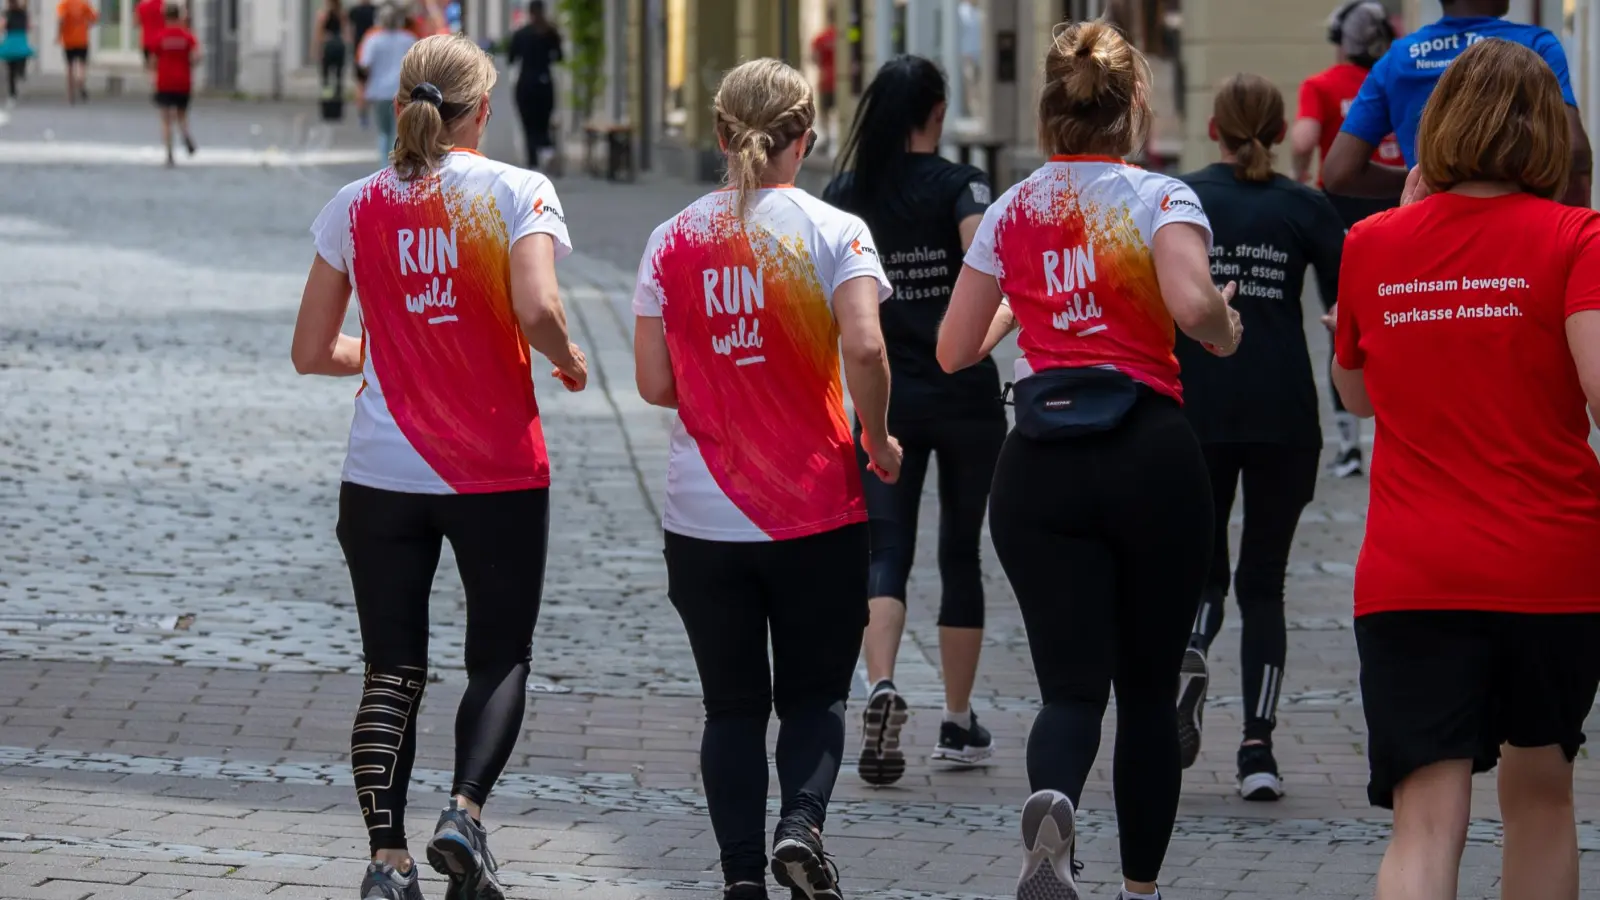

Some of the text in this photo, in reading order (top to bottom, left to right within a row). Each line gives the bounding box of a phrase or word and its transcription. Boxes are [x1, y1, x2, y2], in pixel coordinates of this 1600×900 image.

[1409, 33, 1459, 58] sport
[397, 227, 458, 276] RUN
[1235, 243, 1289, 264] strahlen
[1042, 242, 1097, 297] RUN
[1251, 265, 1286, 282] essen
[406, 277, 457, 314] wild
[702, 265, 765, 318] RUN
[1239, 279, 1284, 300] küssen
[1378, 276, 1530, 297] Gemeinsam bewegen.
[1053, 291, 1102, 331] wild
[1383, 302, 1524, 328] Sparkasse Ansbach.
[712, 316, 764, 355] wild
